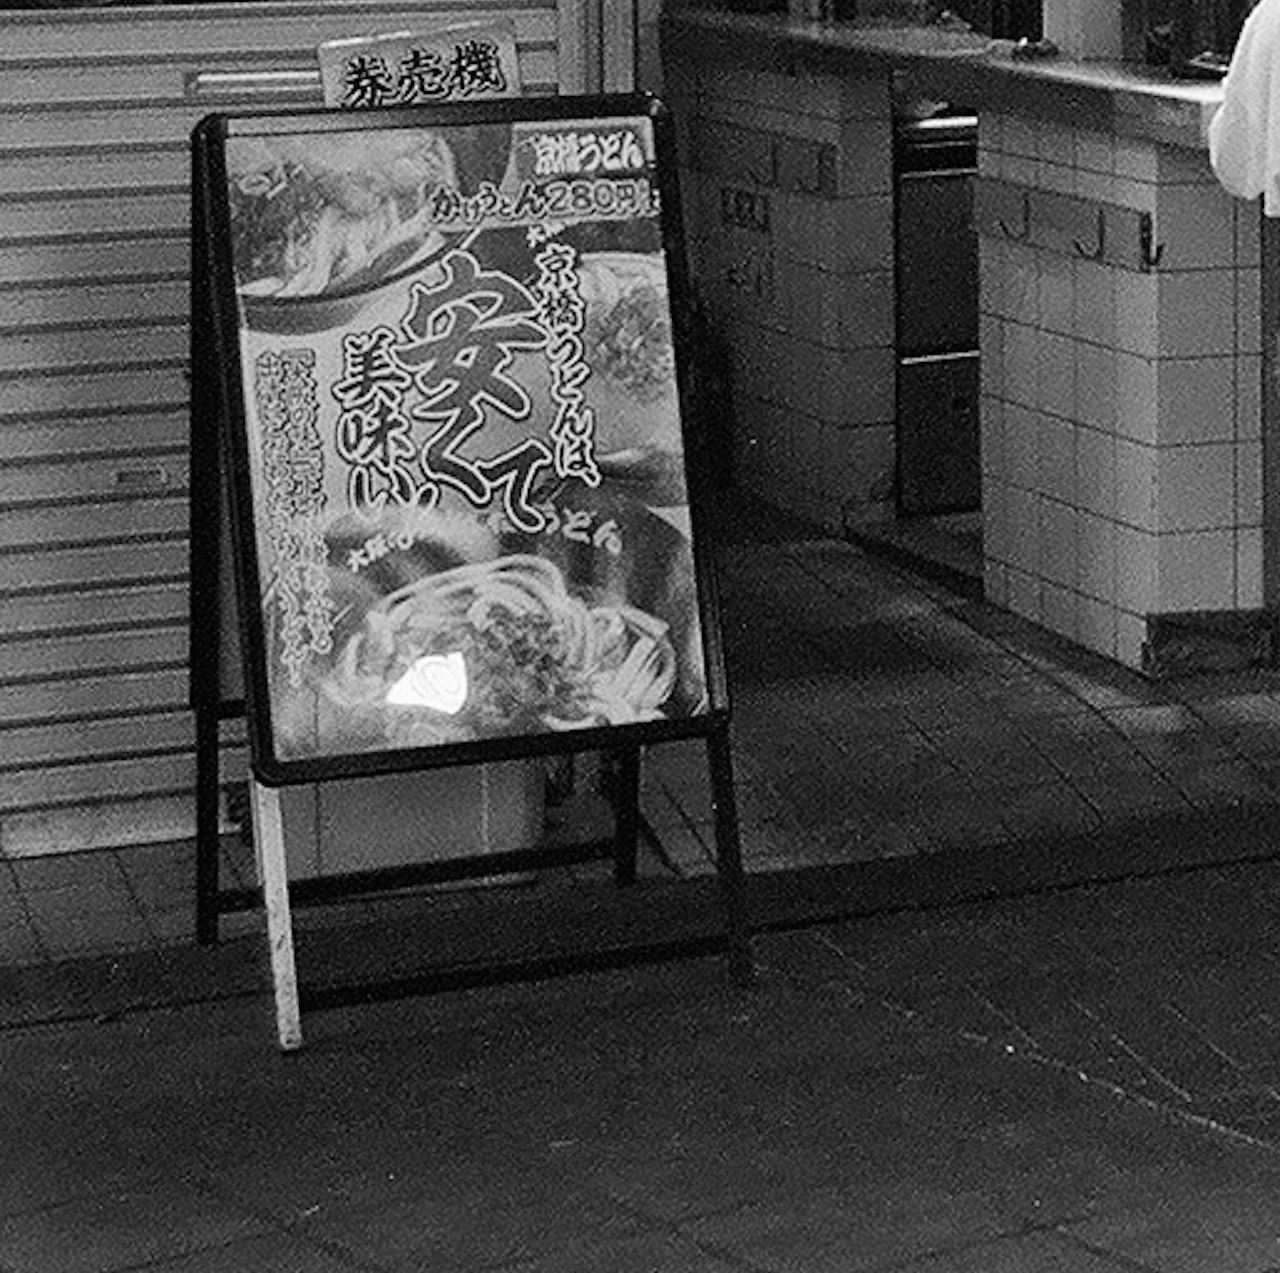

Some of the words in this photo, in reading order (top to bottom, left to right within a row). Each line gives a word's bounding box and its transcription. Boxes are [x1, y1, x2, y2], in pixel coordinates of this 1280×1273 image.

[340, 38, 509, 106] 券売機
[404, 248, 553, 532] 安くて
